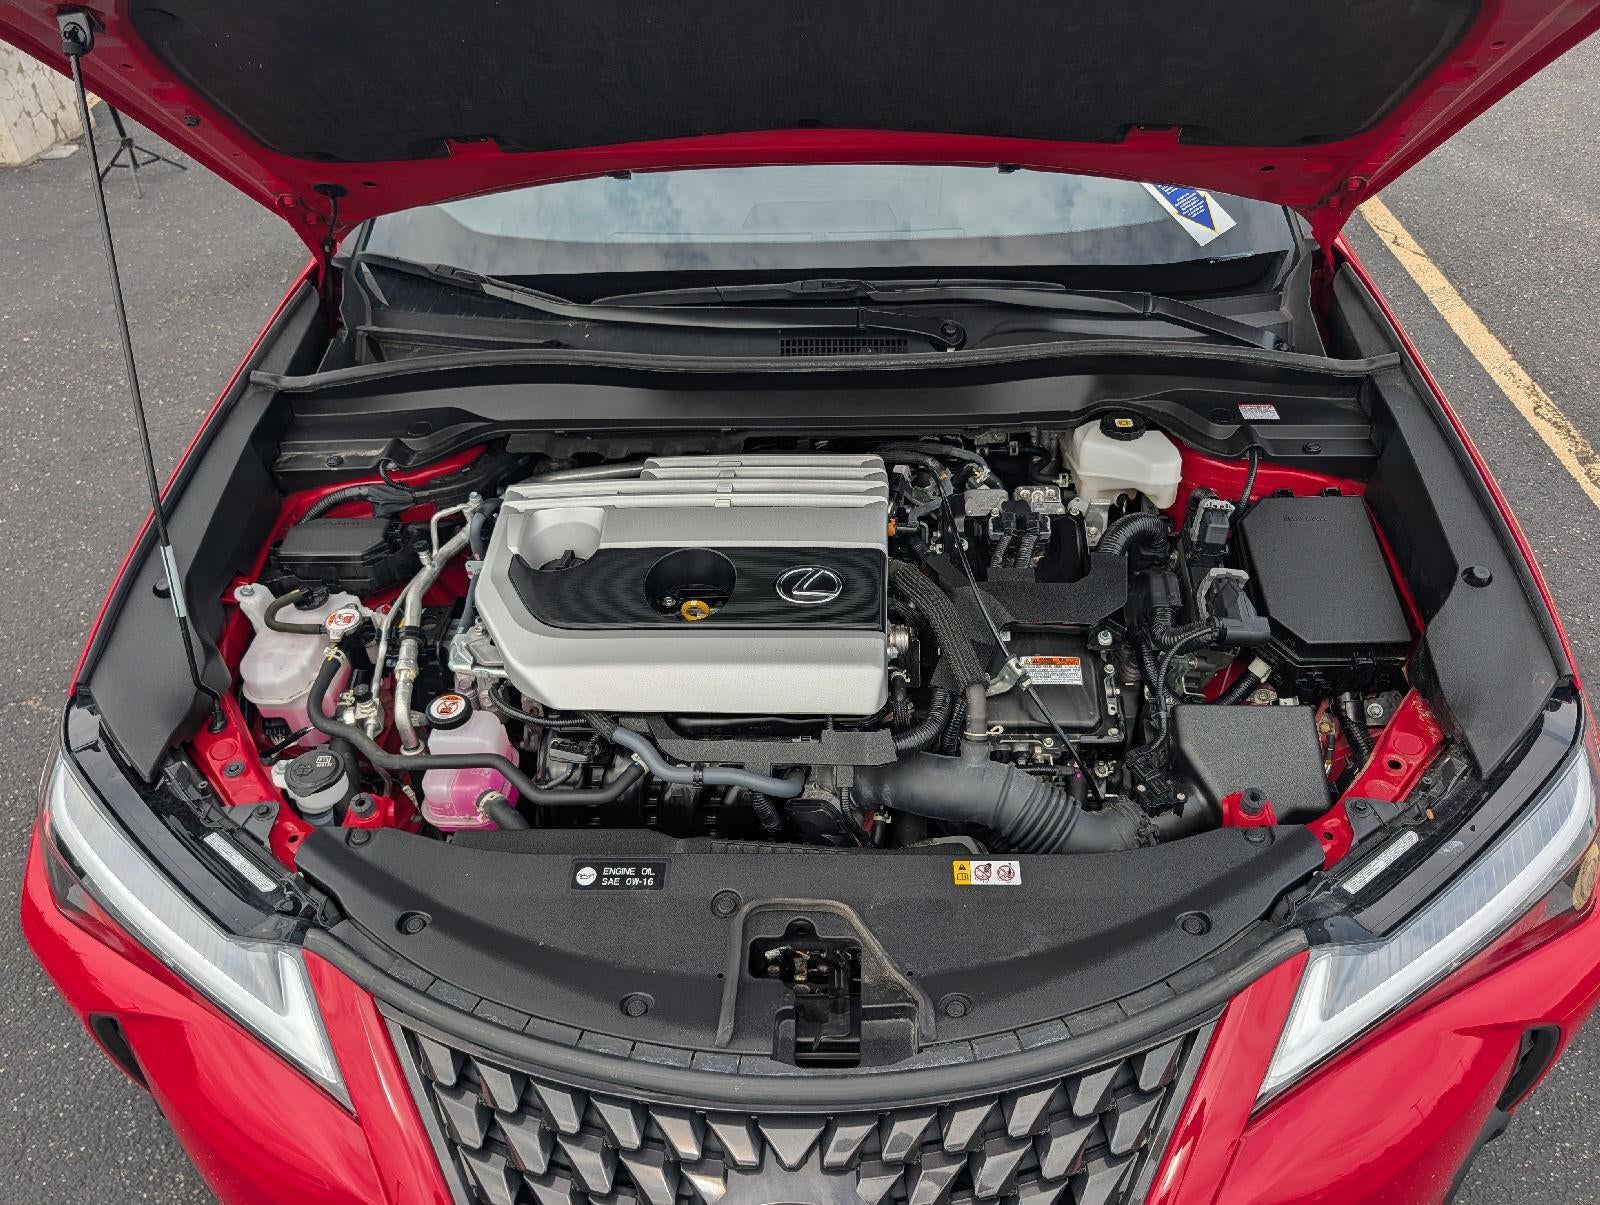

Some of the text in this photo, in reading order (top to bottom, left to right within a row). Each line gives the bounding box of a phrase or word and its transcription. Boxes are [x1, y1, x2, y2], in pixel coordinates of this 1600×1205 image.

[603, 867, 656, 876] ENGINE OIL
[601, 877, 654, 886] SAE 0W-16
